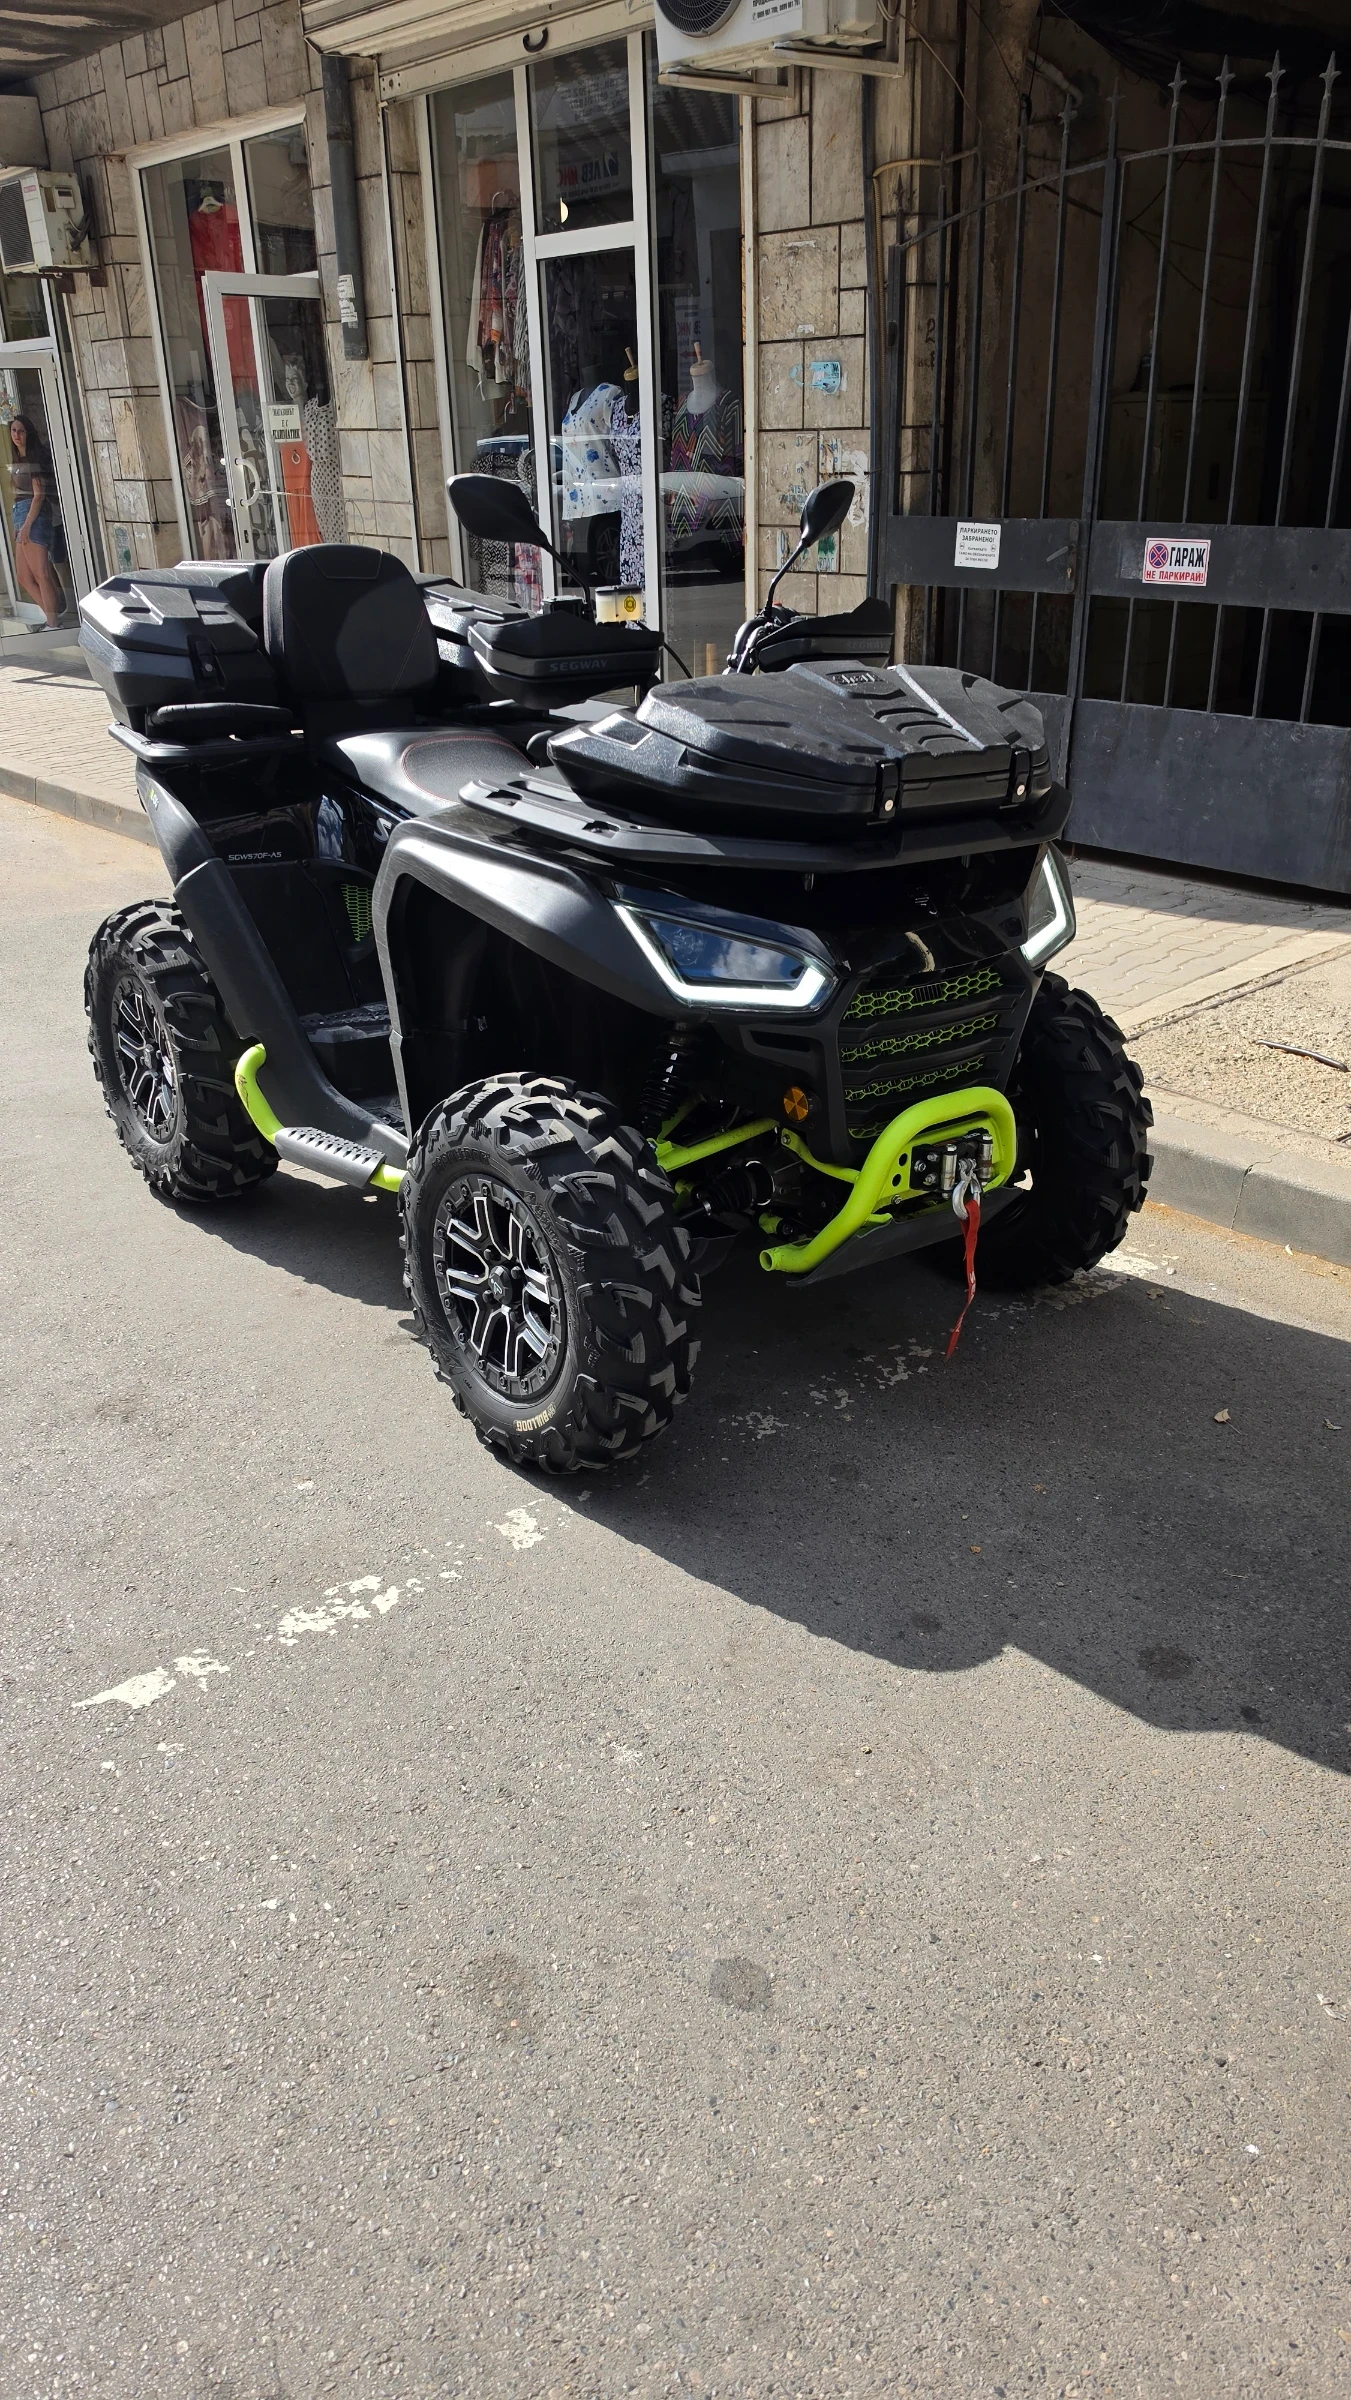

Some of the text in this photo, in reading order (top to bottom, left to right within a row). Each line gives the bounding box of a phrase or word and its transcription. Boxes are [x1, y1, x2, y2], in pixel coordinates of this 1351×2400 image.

[960, 527, 997, 535] ПАРКИРАНЕТО
[1169, 547, 1206, 567] ГАРАЖ
[1146, 570, 1204, 581] НЕ ПАРКИРАЙ!
[549, 660, 608, 672] SEGWAY
[515, 1410, 550, 1432] BULLDOG
